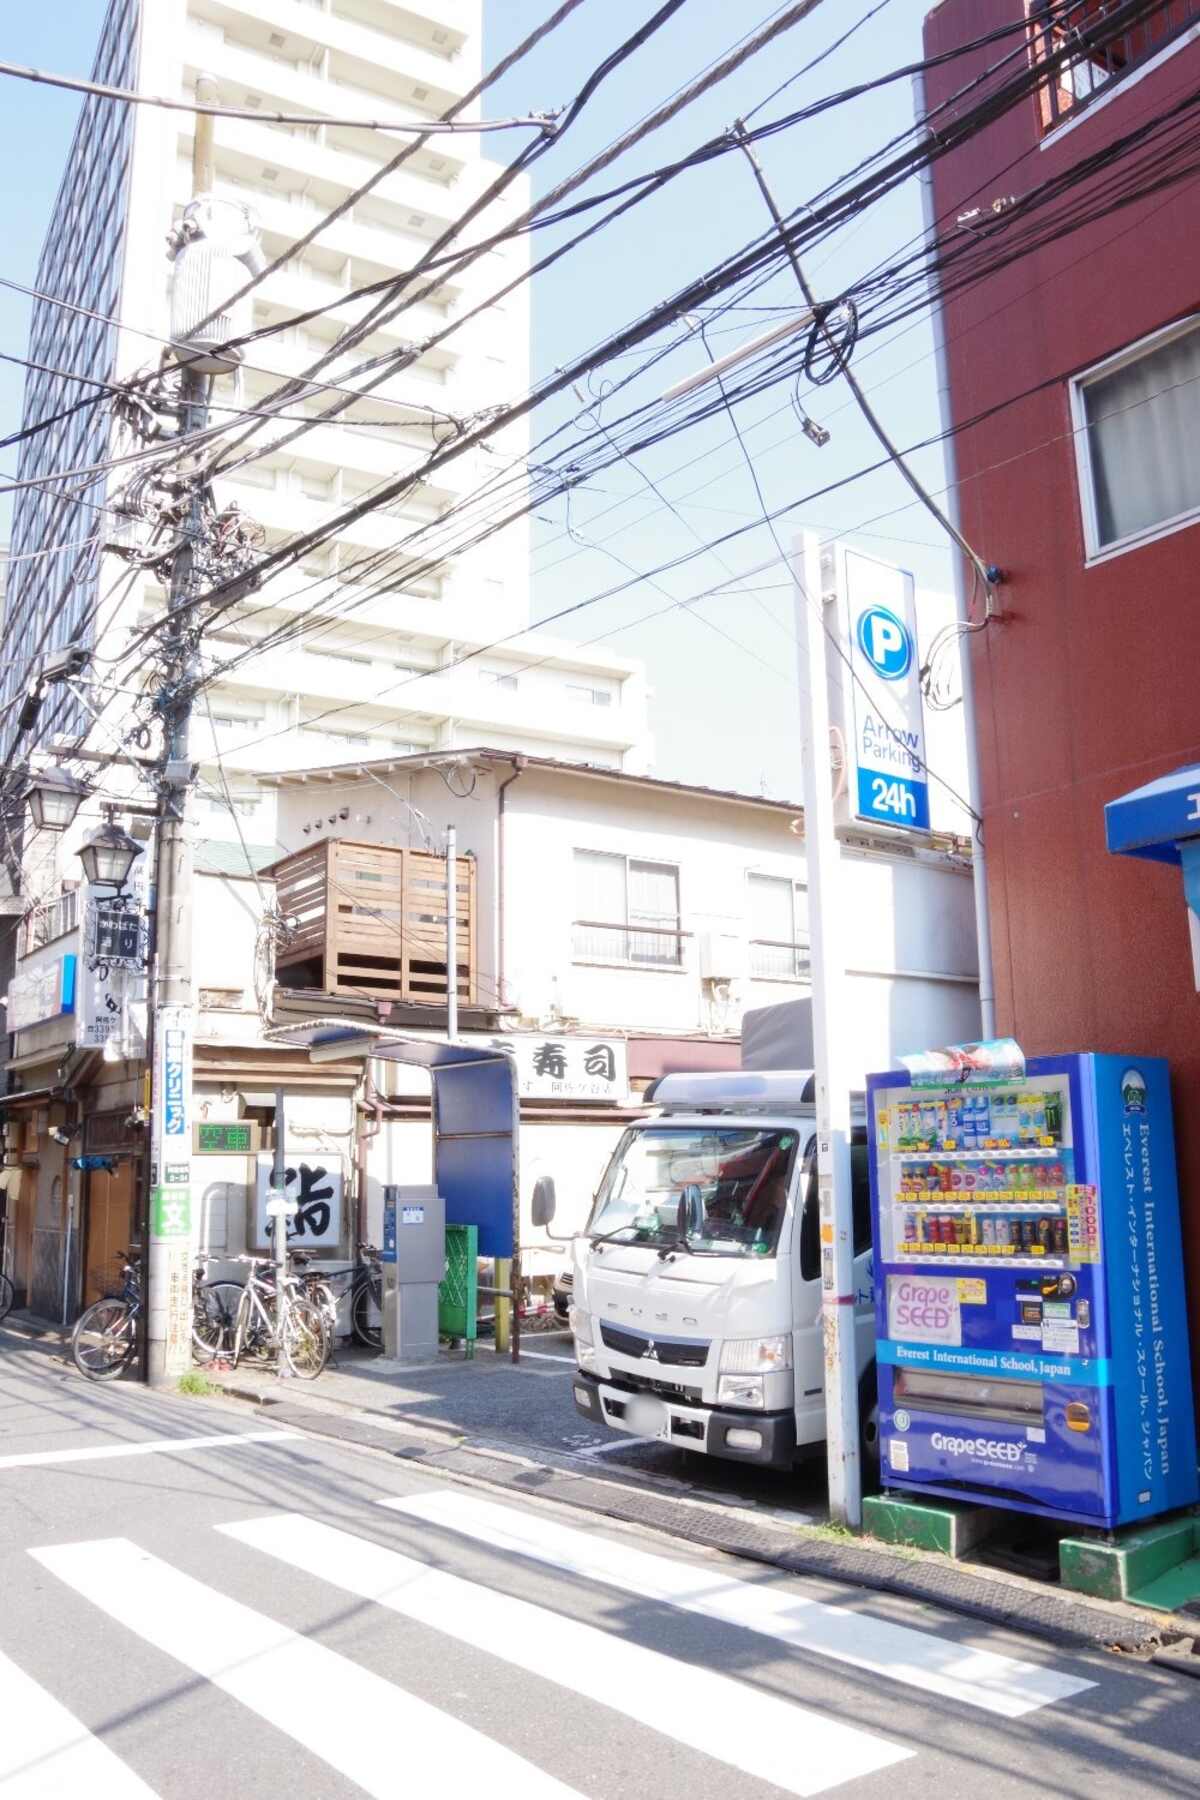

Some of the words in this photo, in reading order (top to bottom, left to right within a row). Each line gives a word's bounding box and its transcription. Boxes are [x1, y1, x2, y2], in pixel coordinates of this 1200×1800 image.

[871, 614, 903, 665] P
[863, 714, 919, 749] Arrow
[863, 736, 921, 774] Parking
[871, 777, 917, 818] 24h
[200, 1123, 250, 1151] 空車
[1139, 1123, 1153, 1194] Everest
[1144, 1200, 1162, 1333] International
[897, 1282, 950, 1307] Grape
[896, 1305, 950, 1329] SEED
[896, 1345, 930, 1361] Everest
[933, 1349, 998, 1369] International
[1039, 1361, 1071, 1378] Japan
[930, 1432, 1022, 1462] GrapeSEED
[1157, 1417, 1170, 1475] Japan
